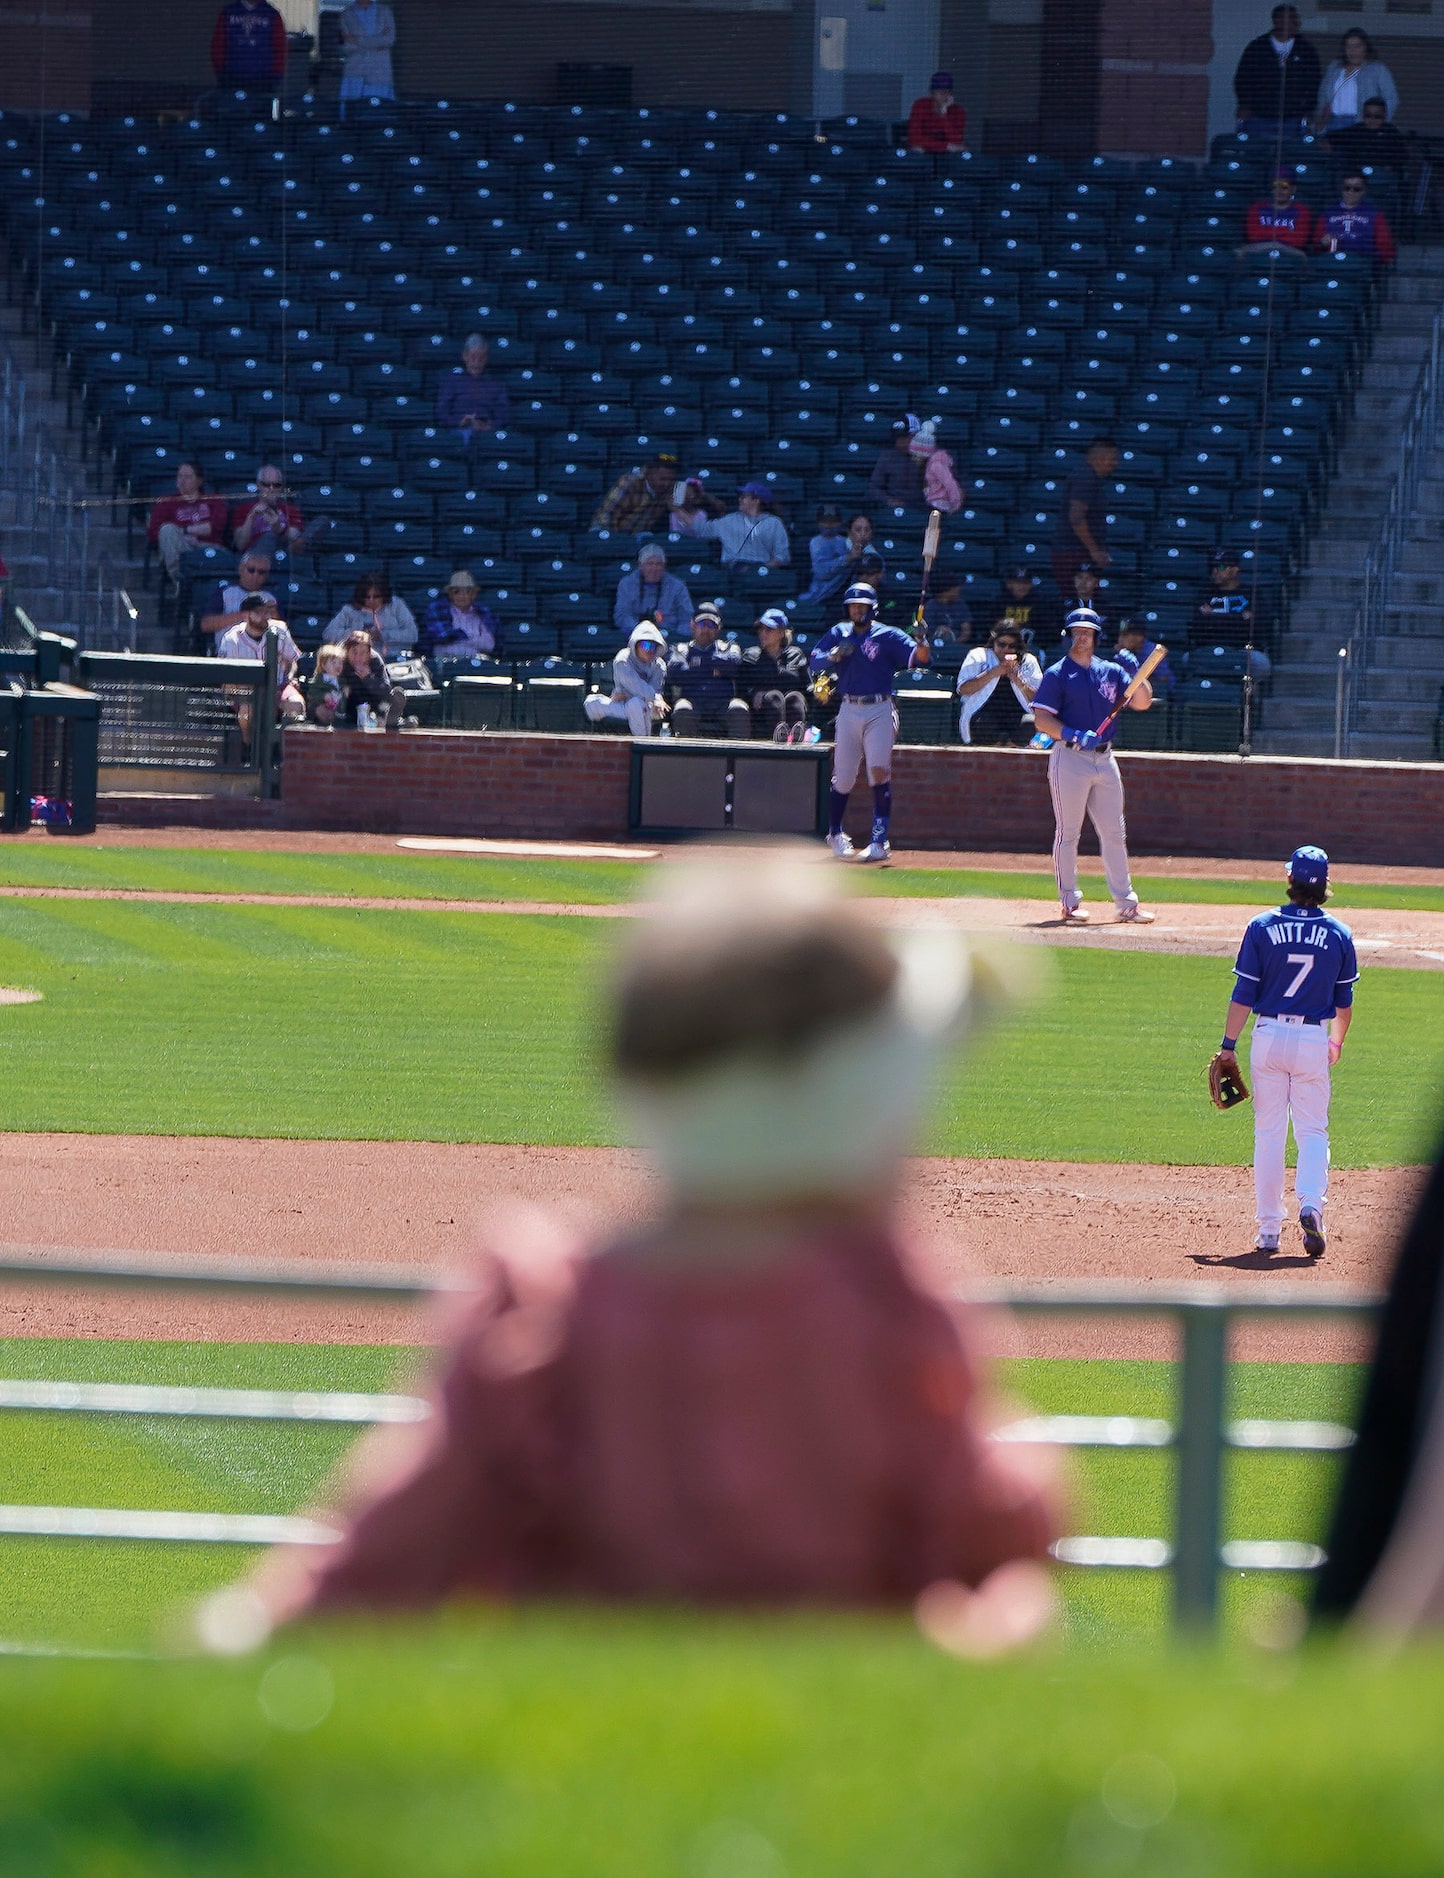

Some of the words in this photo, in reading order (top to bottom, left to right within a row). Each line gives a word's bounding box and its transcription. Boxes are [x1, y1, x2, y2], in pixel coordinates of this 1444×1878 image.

[1266, 922, 1304, 946] WITT
[1304, 925, 1329, 950] JR.
[1283, 953, 1314, 998] 7
